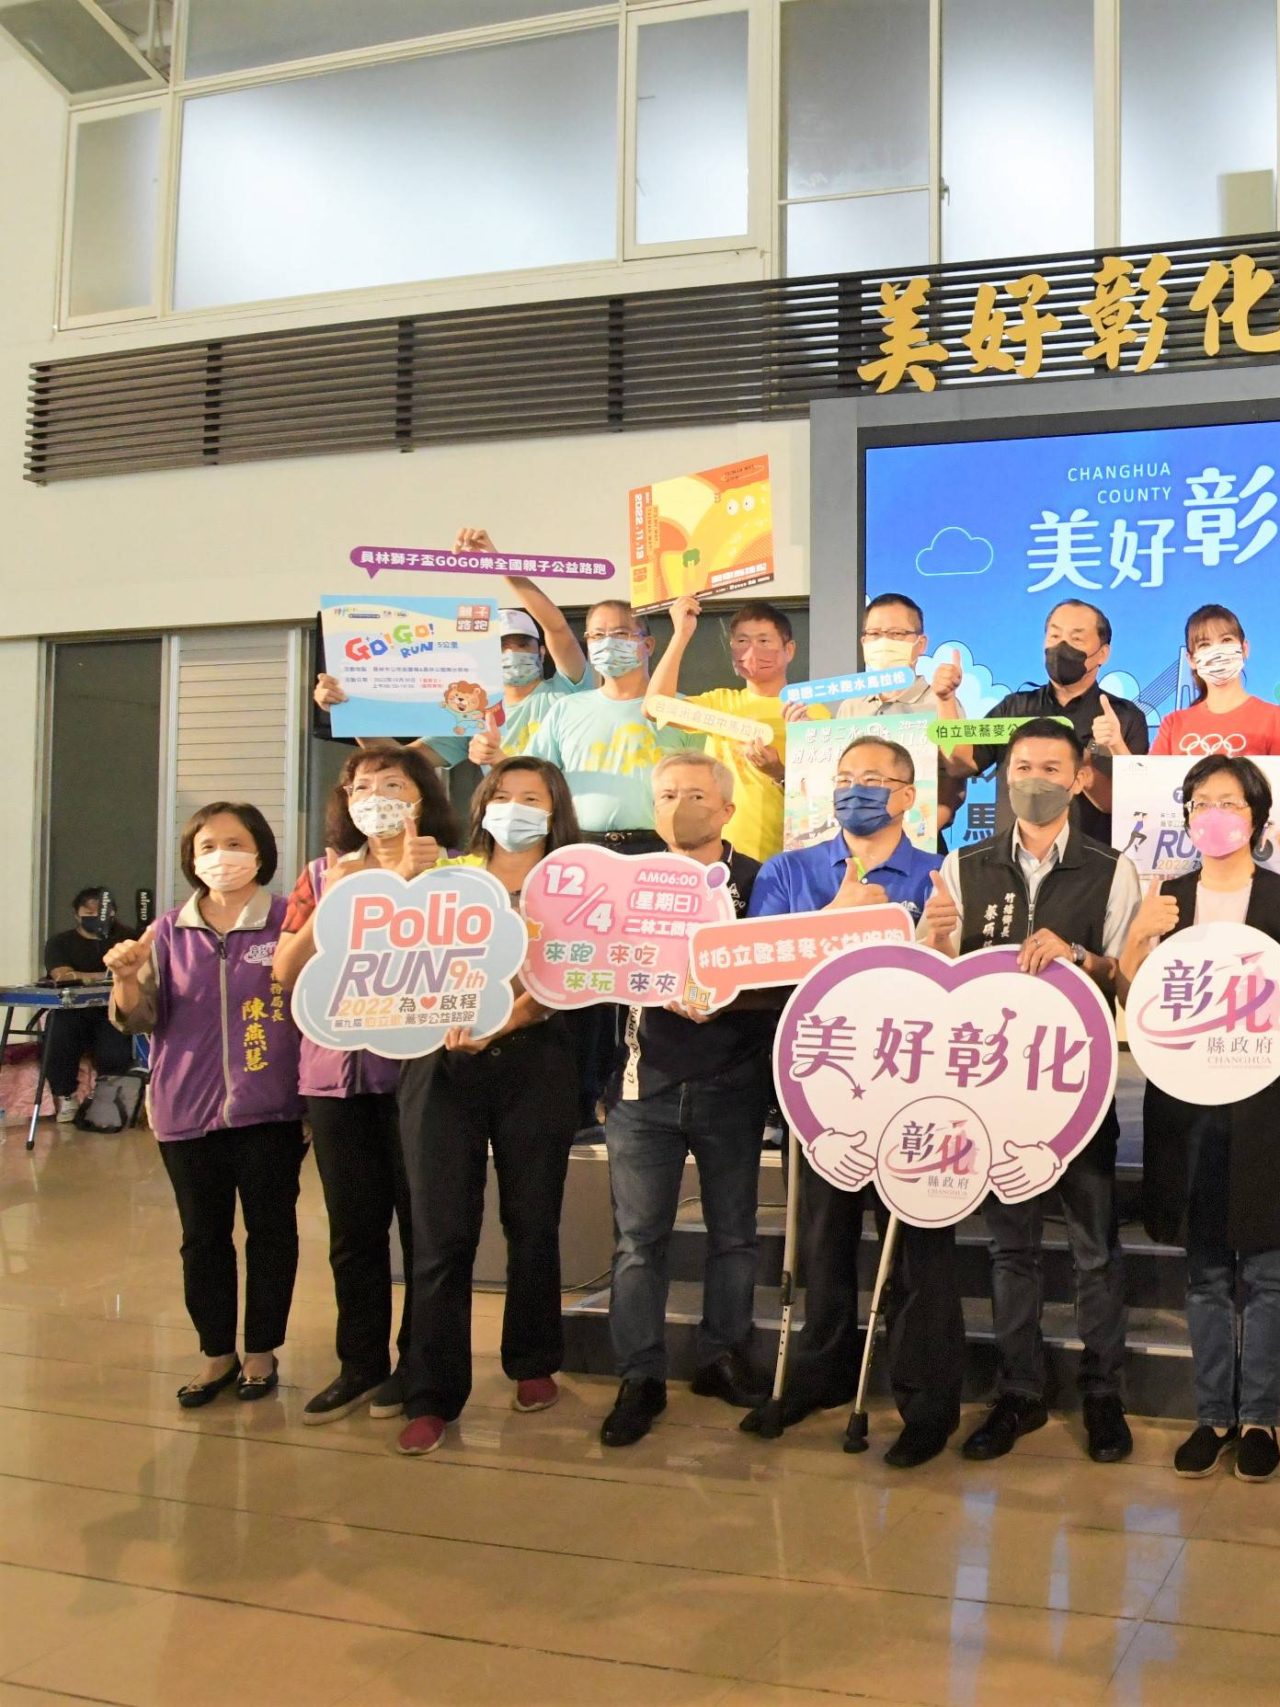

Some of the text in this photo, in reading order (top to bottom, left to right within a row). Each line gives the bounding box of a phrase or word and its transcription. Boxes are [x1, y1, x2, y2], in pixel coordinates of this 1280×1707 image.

[1067, 462, 1172, 482] CHANGHUA
[1097, 486, 1172, 504] COUNTY
[400, 641, 434, 659] RUN
[1151, 829, 1202, 870] RU
[1157, 859, 1191, 871] 2022
[638, 871, 699, 887] AM06:00
[349, 891, 493, 950] Polio
[546, 943, 657, 966] 來跑 來吃
[329, 947, 486, 1017] RUN
[449, 960, 486, 991] 9th
[565, 970, 615, 991] 來玩
[1159, 959, 1276, 1034] 彰化
[338, 997, 395, 1017] 2022
[791, 1007, 1090, 1101] 美好彰化
[1207, 1036, 1273, 1055] 縣政府
[1207, 1056, 1272, 1065] CHANGHUA
[899, 1120, 974, 1176] 彰化
[927, 1175, 970, 1190] 縣政府
